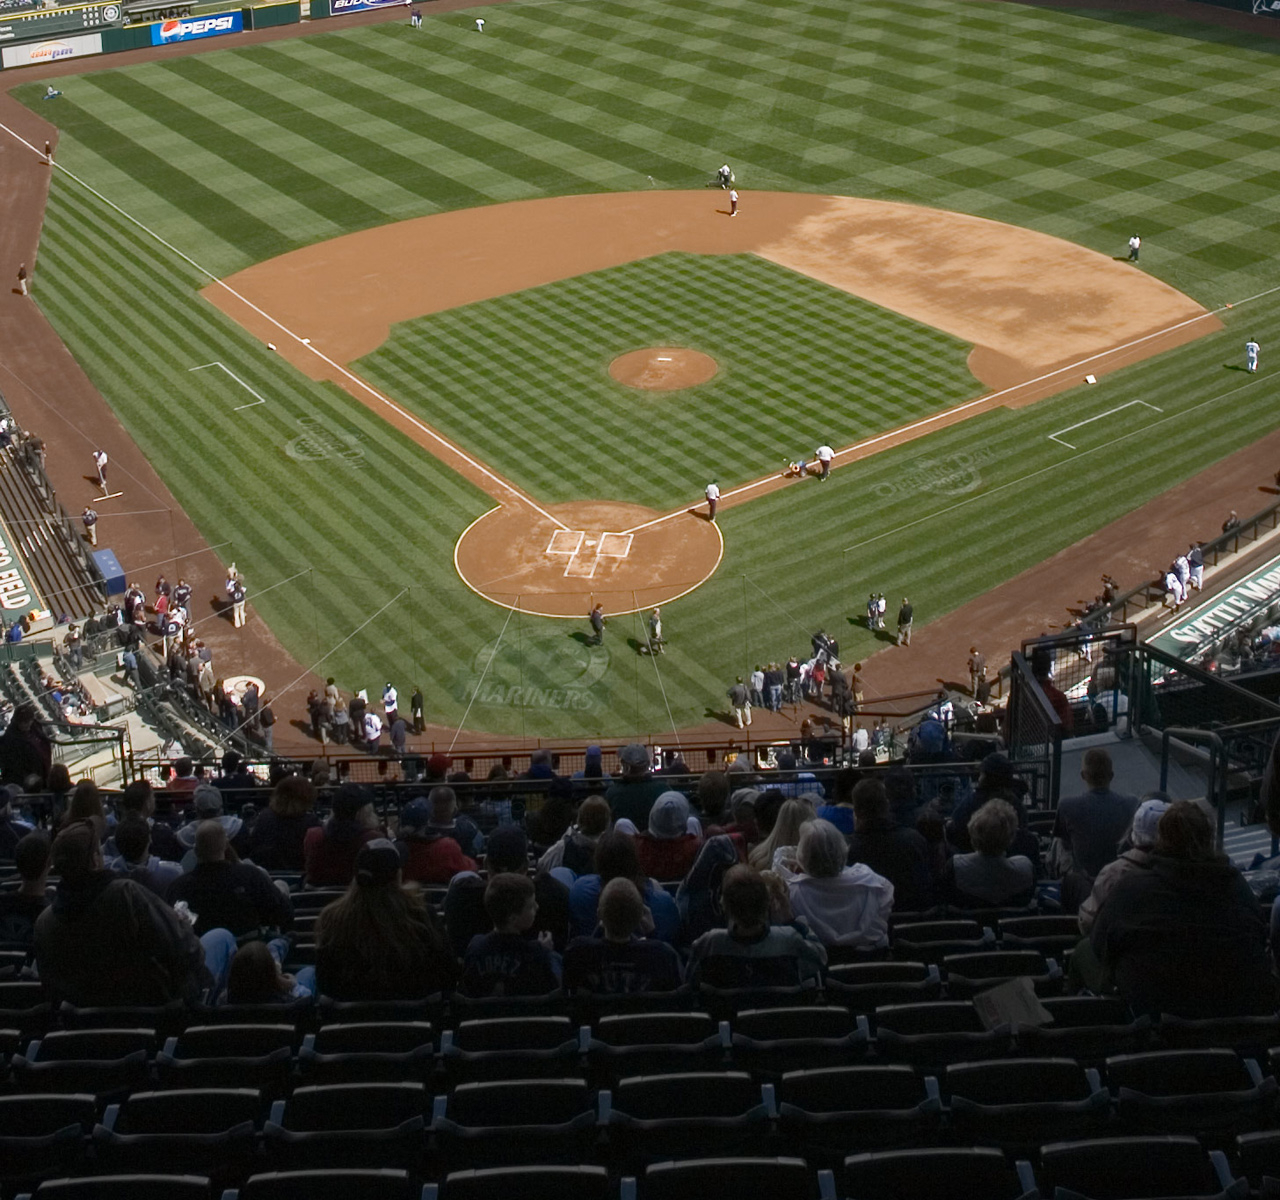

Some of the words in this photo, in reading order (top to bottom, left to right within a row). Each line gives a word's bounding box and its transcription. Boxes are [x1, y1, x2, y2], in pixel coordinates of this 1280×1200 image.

[180, 16, 234, 36] PEPSI
[1170, 593, 1251, 643] SEATTLE
[461, 682, 595, 711] MARINERS
